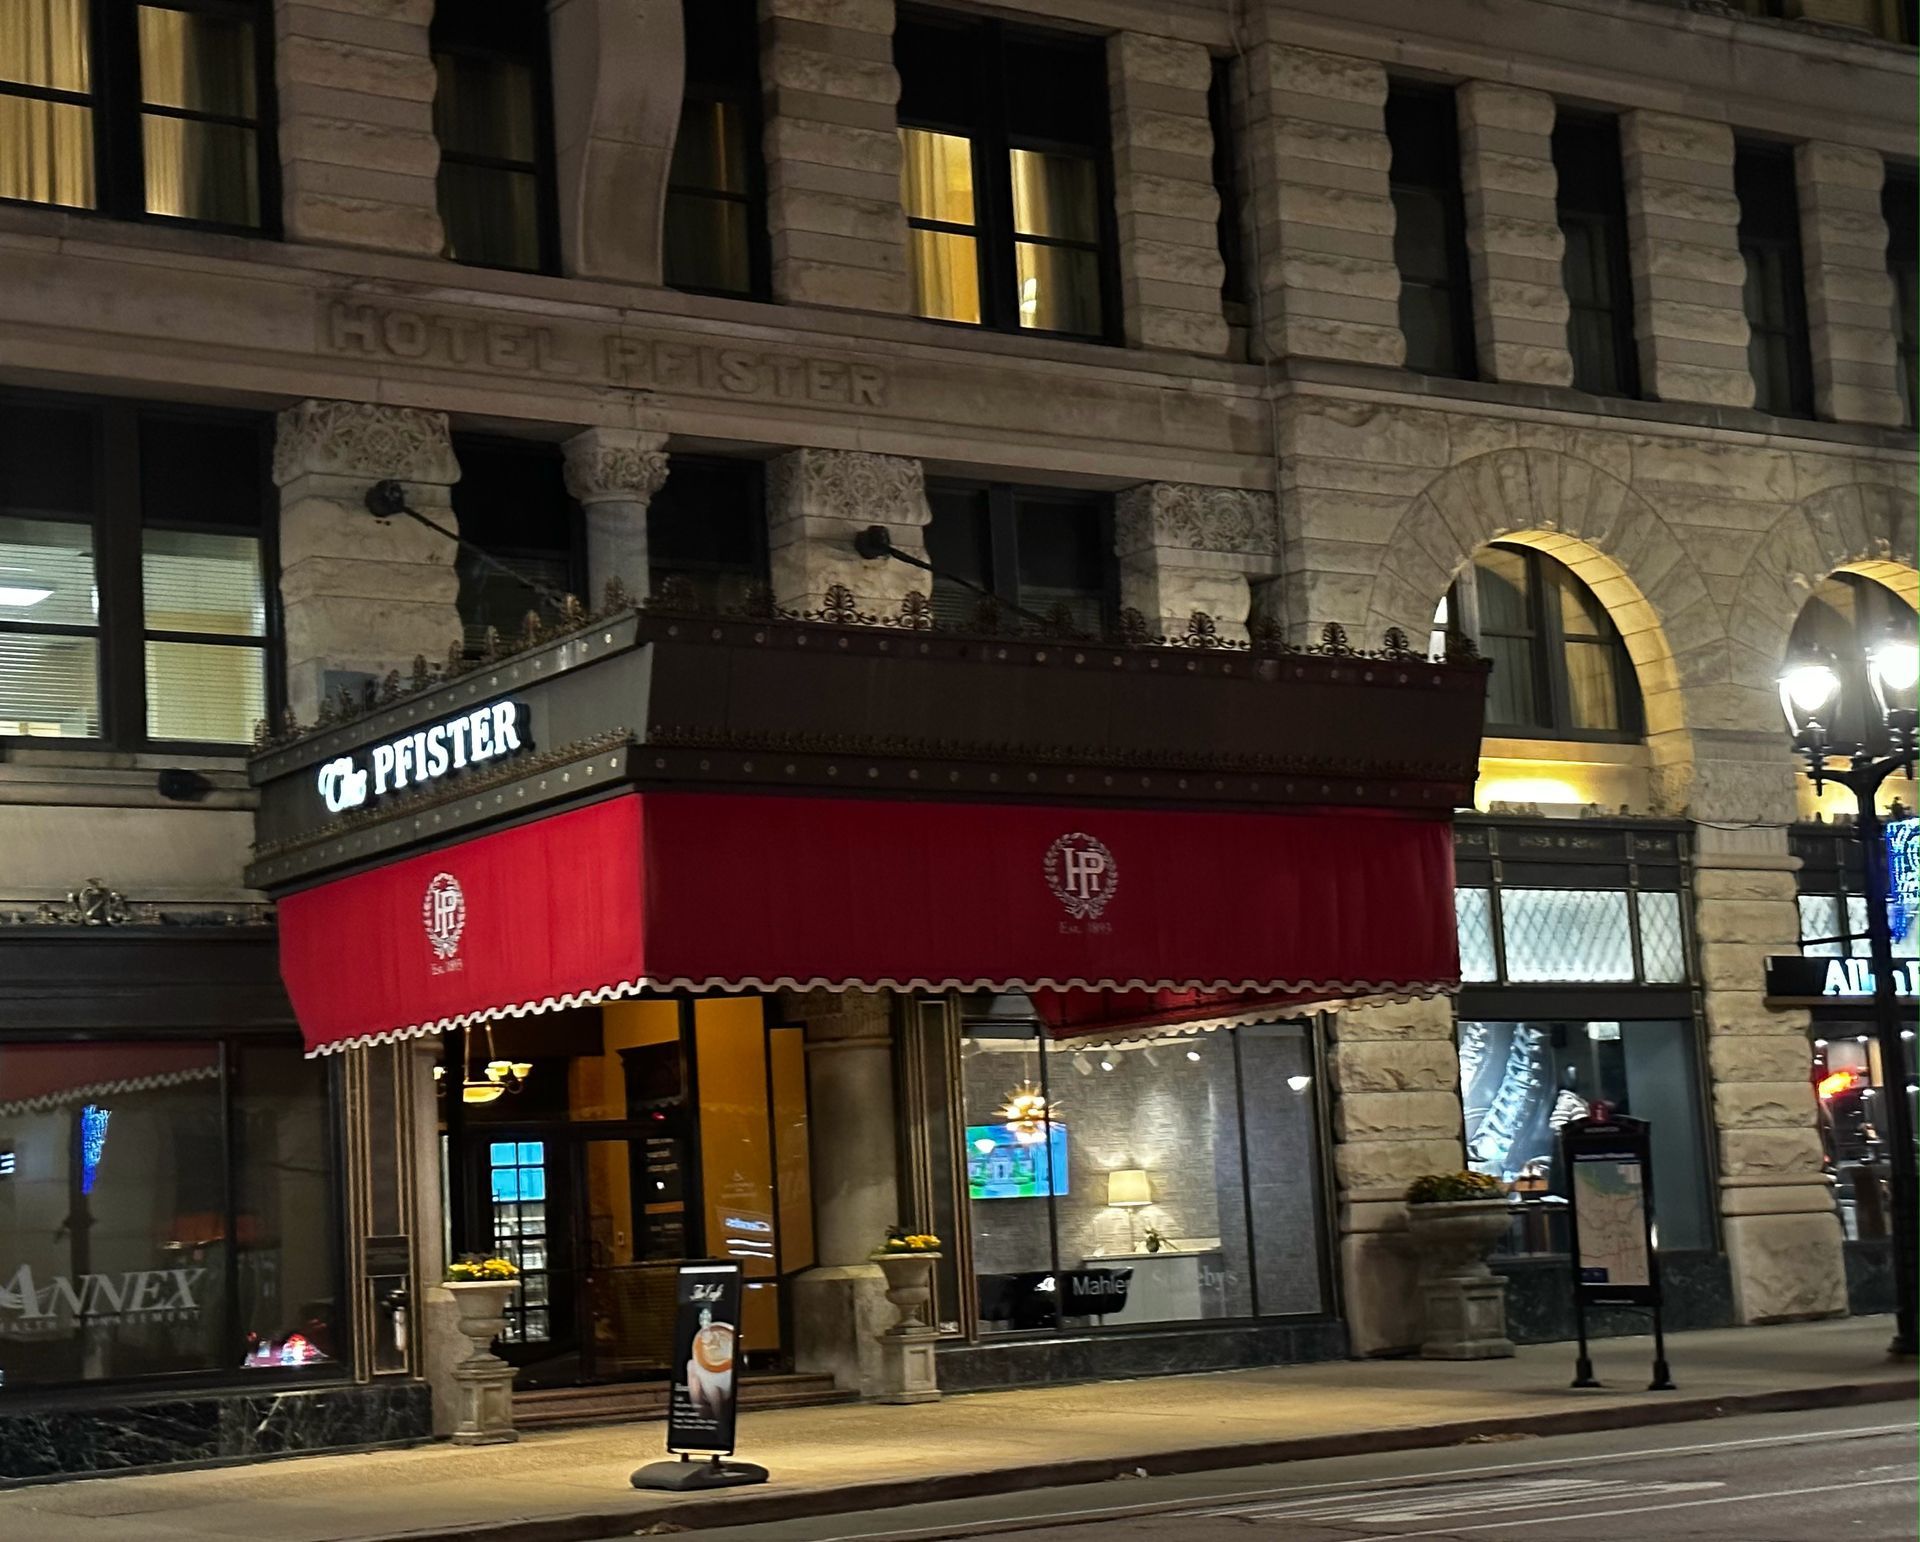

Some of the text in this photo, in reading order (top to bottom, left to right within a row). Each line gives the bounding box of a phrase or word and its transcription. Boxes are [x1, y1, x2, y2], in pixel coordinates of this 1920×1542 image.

[332, 303, 889, 408] HOTEL PFISTER
[317, 700, 521, 813] The PFISTER
[8, 1263, 207, 1319] ANNEX
